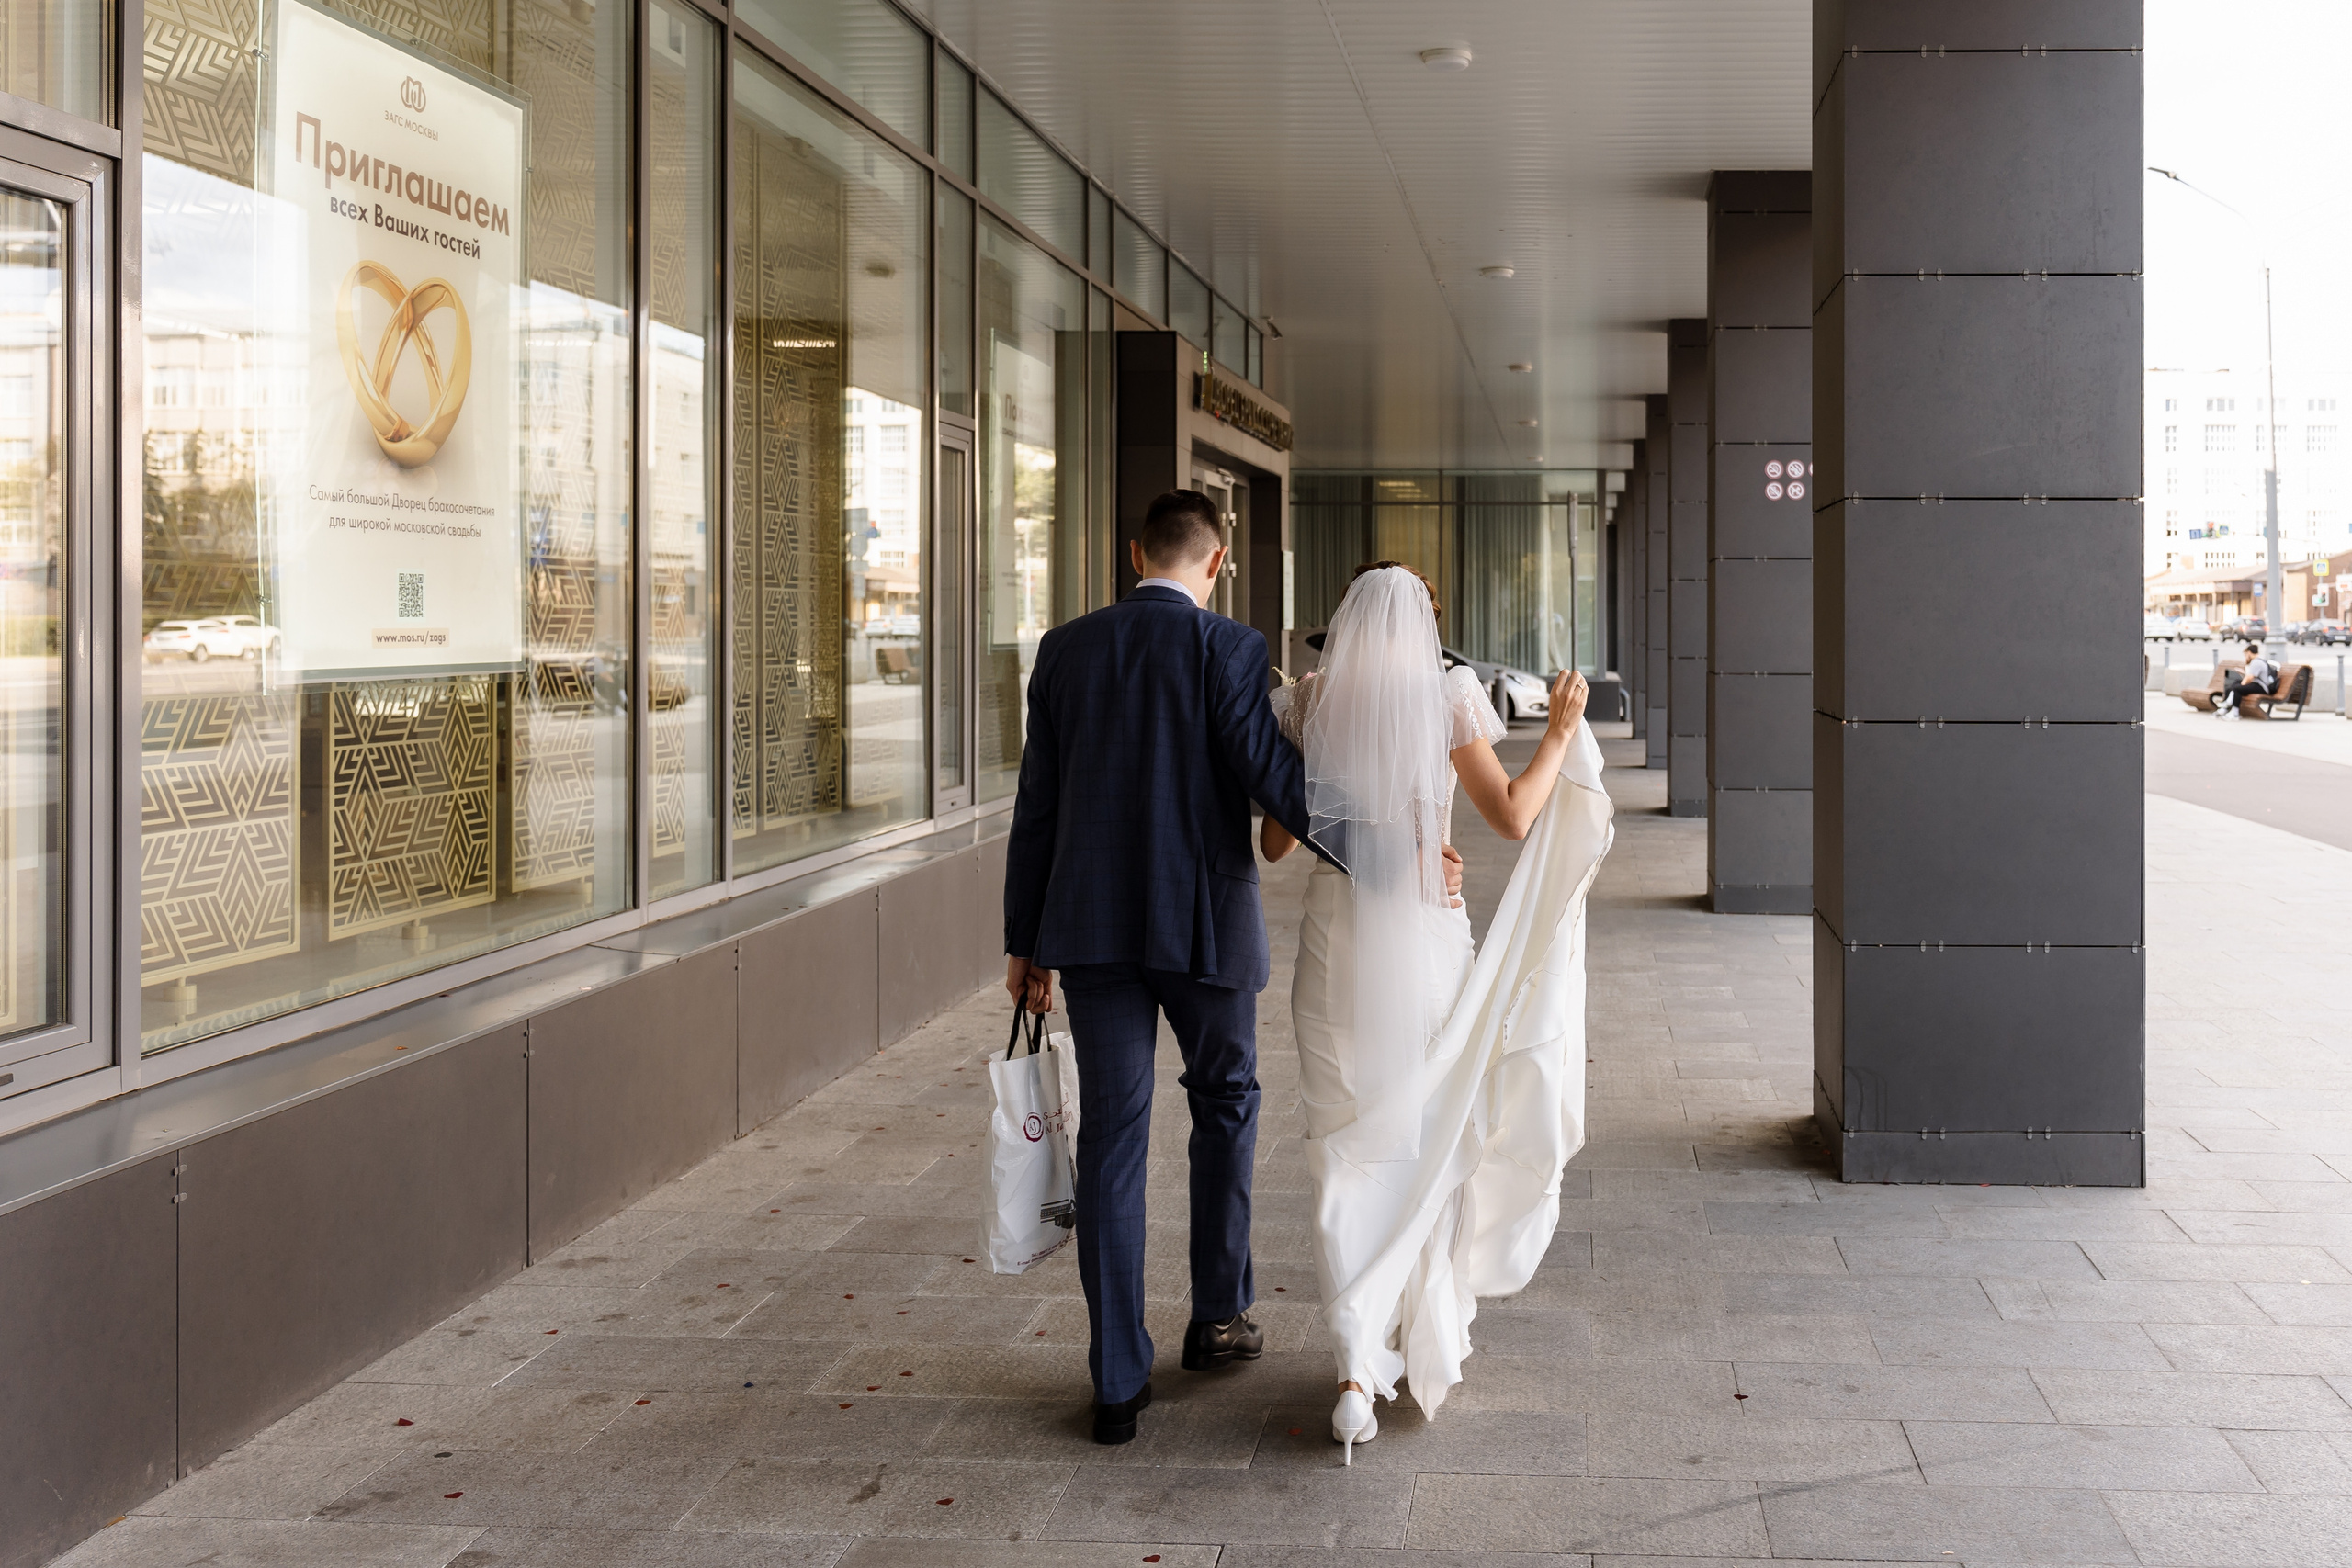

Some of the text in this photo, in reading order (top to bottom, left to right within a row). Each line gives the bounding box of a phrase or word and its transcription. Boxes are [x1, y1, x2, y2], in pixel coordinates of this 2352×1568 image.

[384, 110, 438, 141] ЗАГС МОСКВЫ
[296, 112, 510, 236] Приглашаем
[330, 197, 480, 259] всех Ваших гостей
[309, 484, 495, 516] Самый большой Дворец бракосочетания
[329, 516, 481, 538] для широкой московской свадьбы
[376, 631, 446, 645] www.mos.ru/zags
